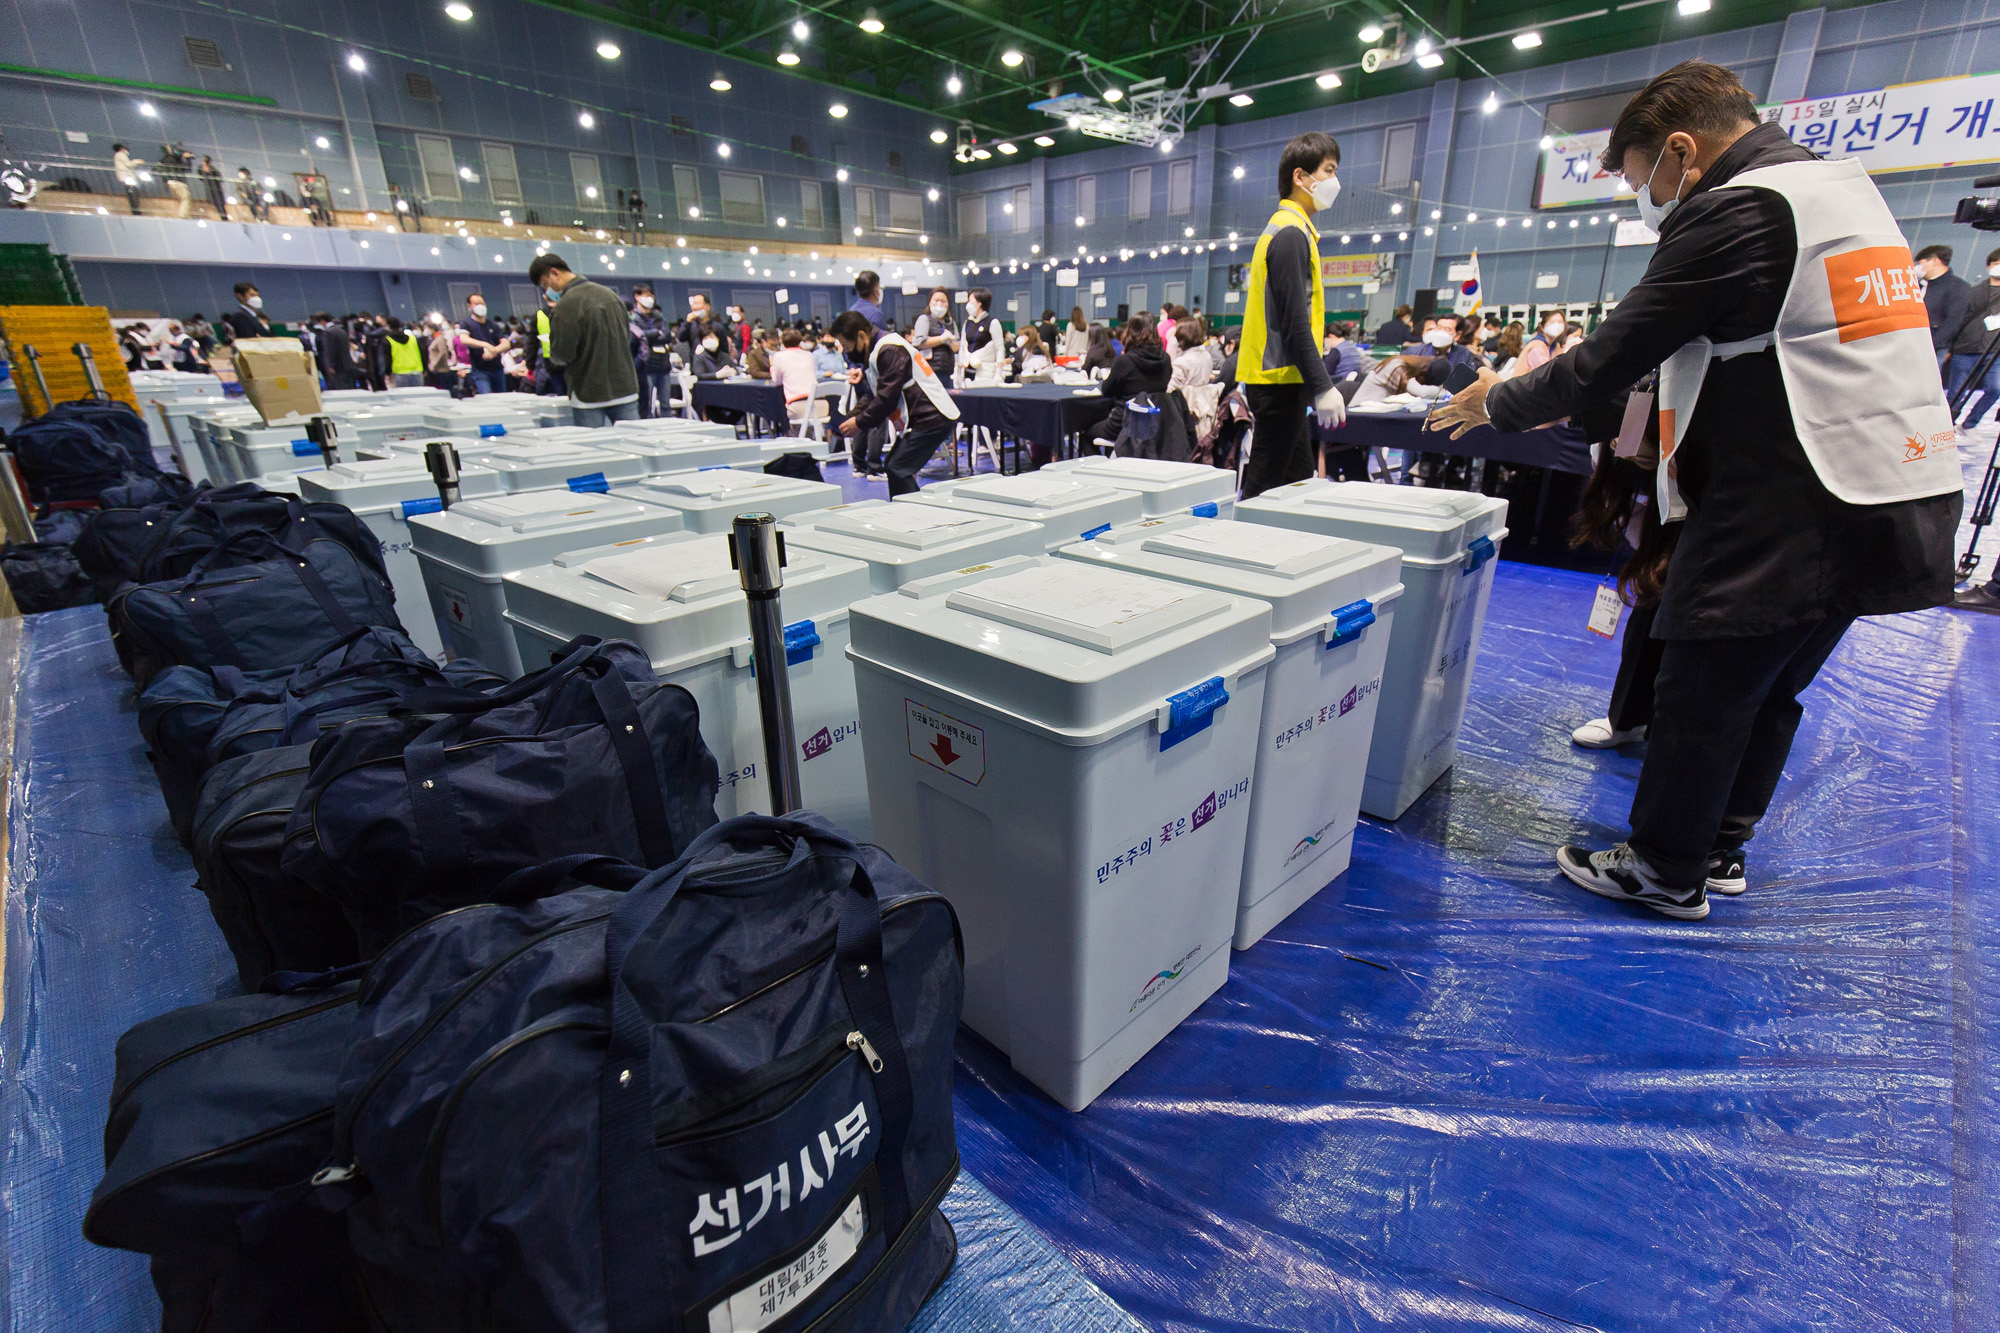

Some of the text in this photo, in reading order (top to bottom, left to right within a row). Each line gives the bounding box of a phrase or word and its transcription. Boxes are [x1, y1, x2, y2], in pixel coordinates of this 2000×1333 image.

[1788, 105, 1930, 156] 원선거
[1945, 97, 2000, 140] 개
[1791, 101, 1836, 120] 15일
[1845, 92, 1887, 115] 실시
[1275, 676, 1380, 750] 민주주의 꽃은 선거입니다
[1096, 776, 1250, 885] 민주주의 꽃은 선거입니다
[689, 1101, 870, 1258] 선거사무
[759, 1239, 829, 1298] 대림제3동
[760, 1258, 829, 1317] 제7투표소
